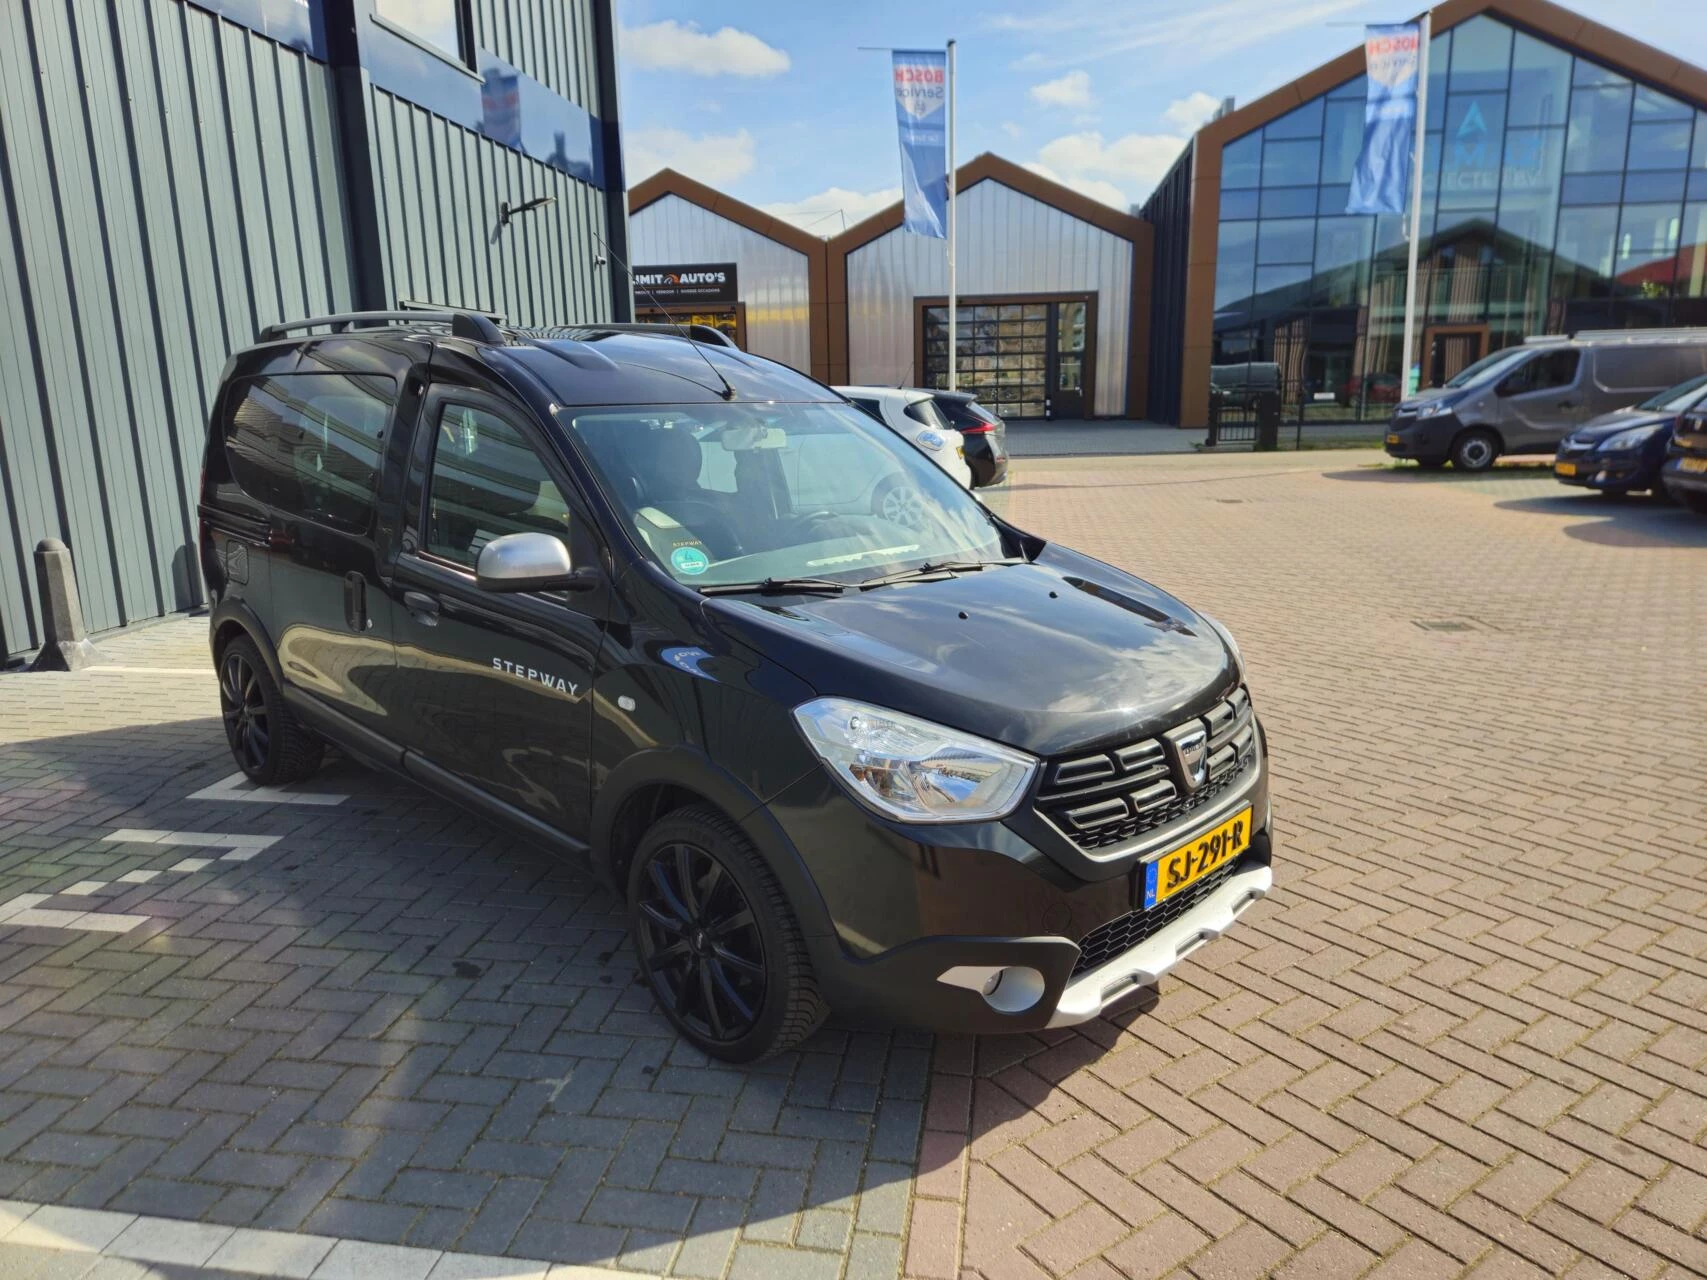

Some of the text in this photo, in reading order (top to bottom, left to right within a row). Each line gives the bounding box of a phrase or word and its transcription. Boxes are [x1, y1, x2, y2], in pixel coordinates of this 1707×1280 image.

[633, 272, 726, 285] IMIT AUTO'S
[492, 657, 578, 696] STEPWAY
[1166, 820, 1243, 890] SJ-291-R
[1146, 889, 1156, 899] NL
